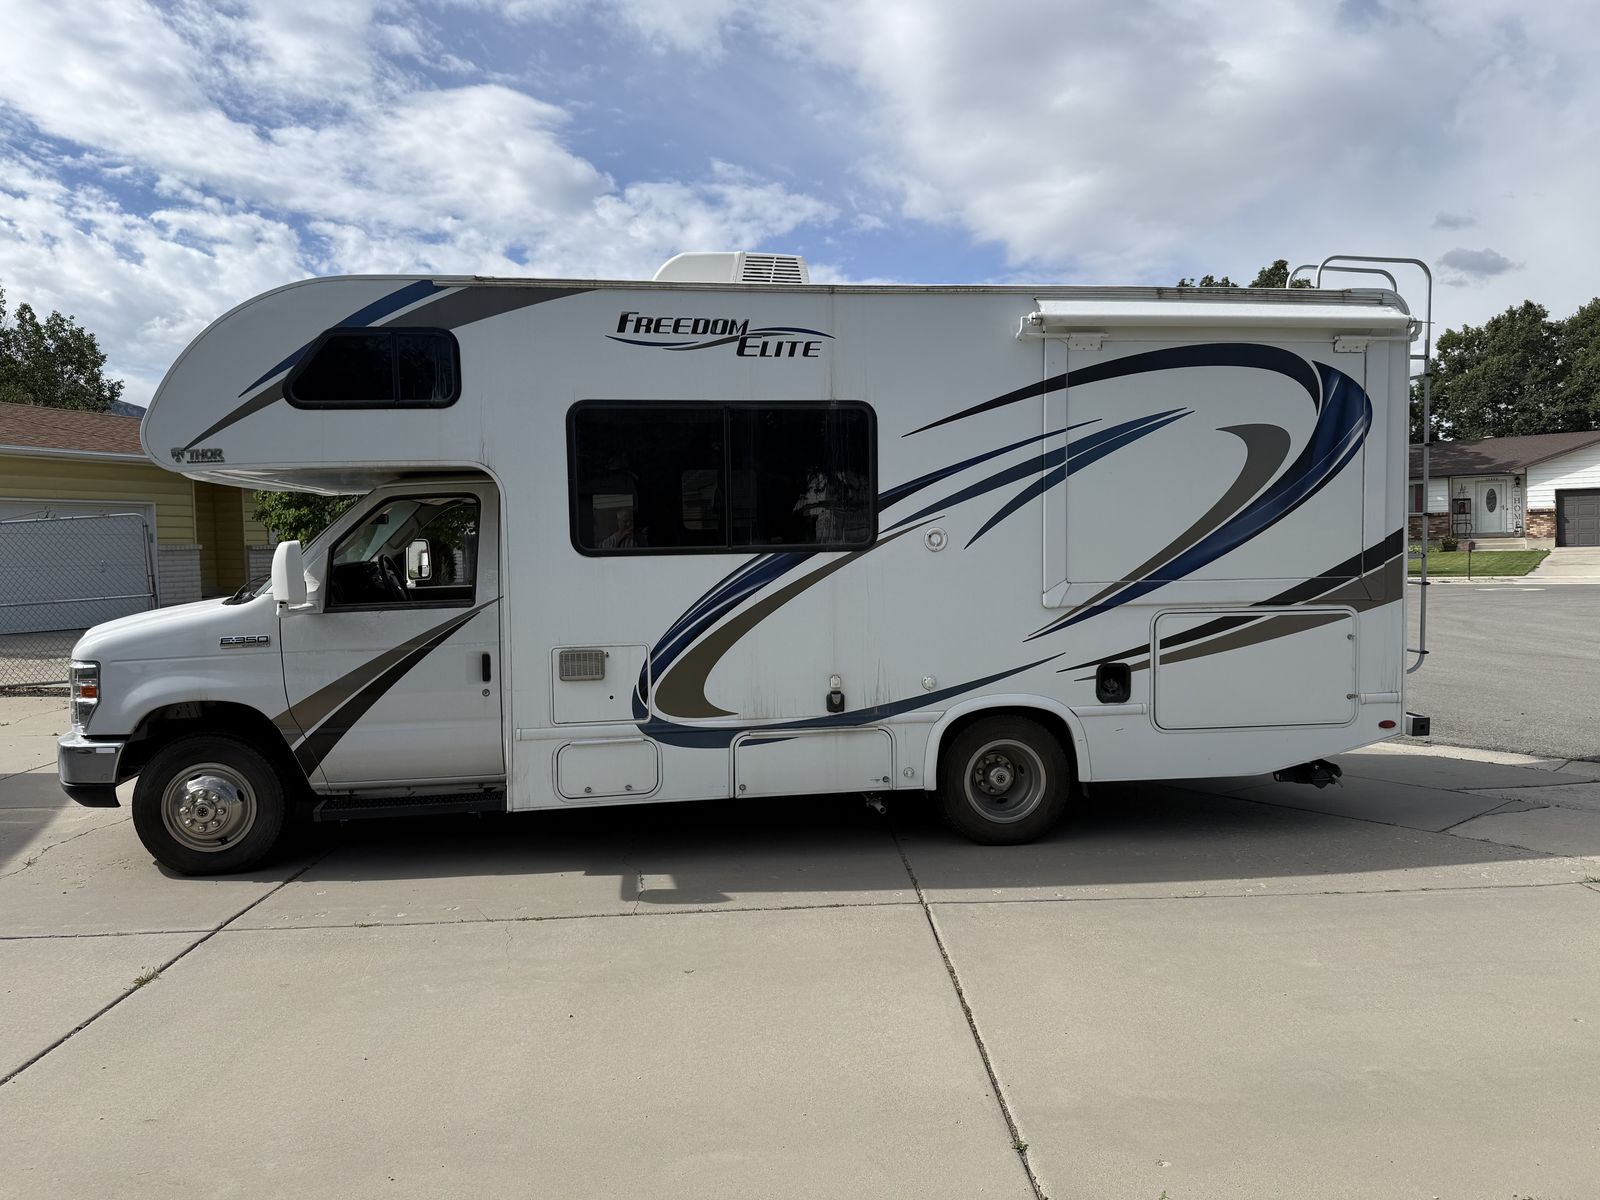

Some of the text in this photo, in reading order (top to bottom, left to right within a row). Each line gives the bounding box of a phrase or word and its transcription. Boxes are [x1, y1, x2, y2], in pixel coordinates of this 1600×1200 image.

[616, 311, 750, 336] FREEDOM
[736, 336, 823, 358] ELITE
[186, 448, 225, 461] THOR
